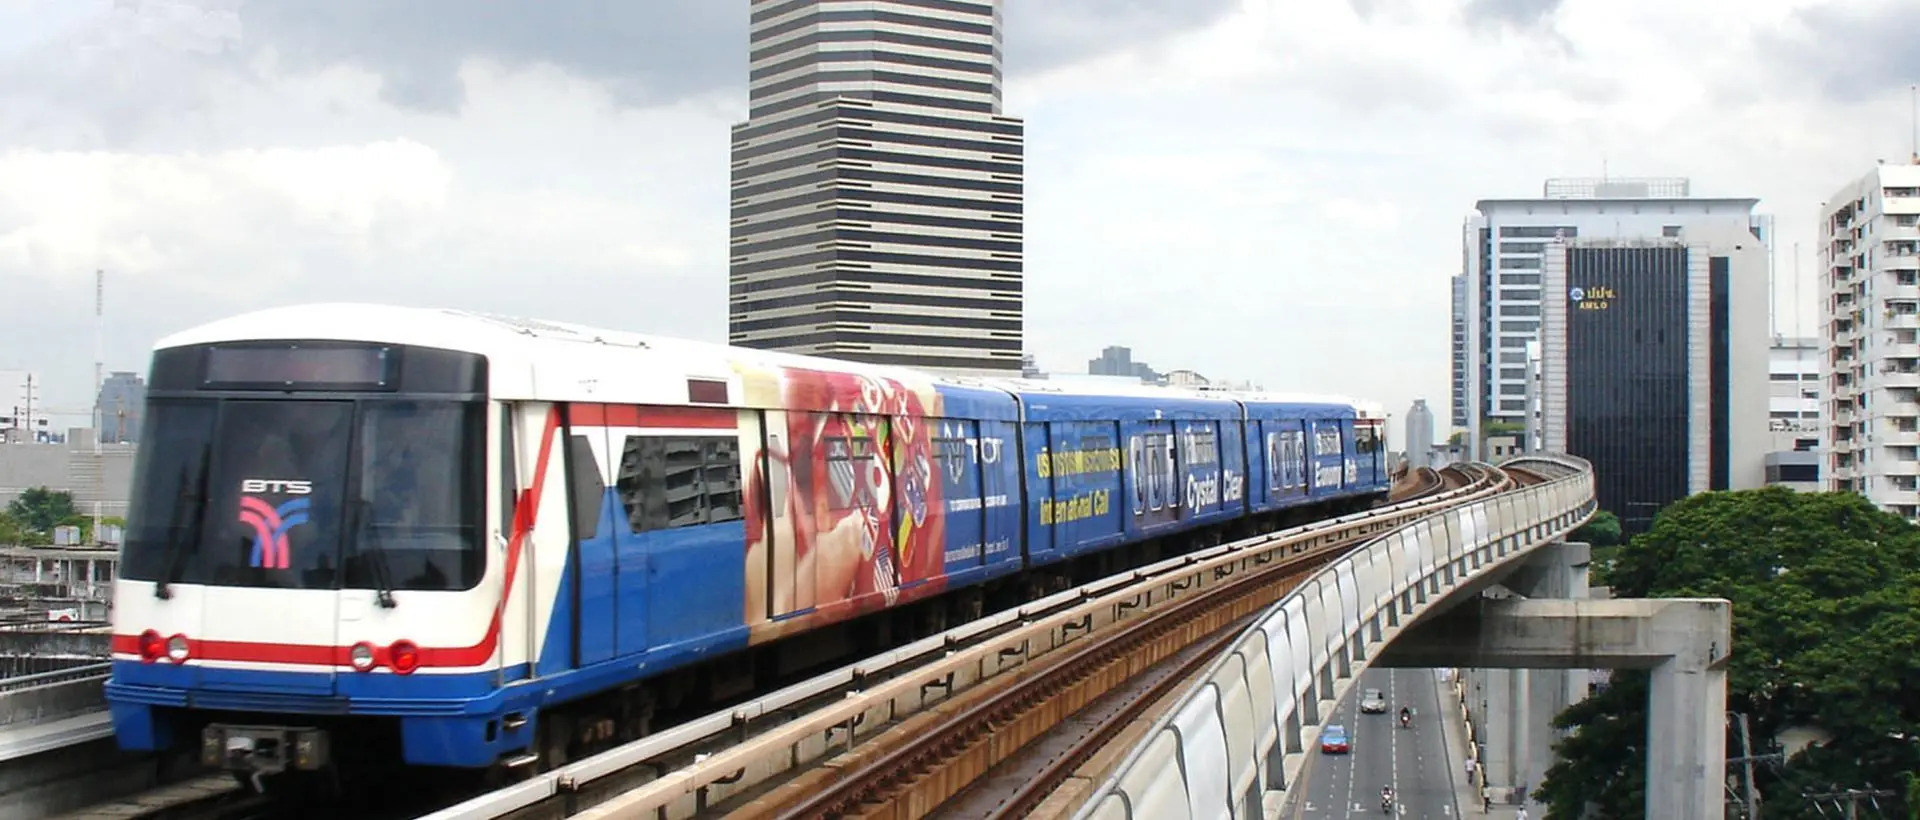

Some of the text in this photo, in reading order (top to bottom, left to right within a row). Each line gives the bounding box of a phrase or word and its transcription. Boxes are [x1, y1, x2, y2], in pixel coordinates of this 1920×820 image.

[965, 437, 1004, 464] TOT
[242, 479, 312, 494] BTS
[1187, 471, 1218, 514] Crystal
